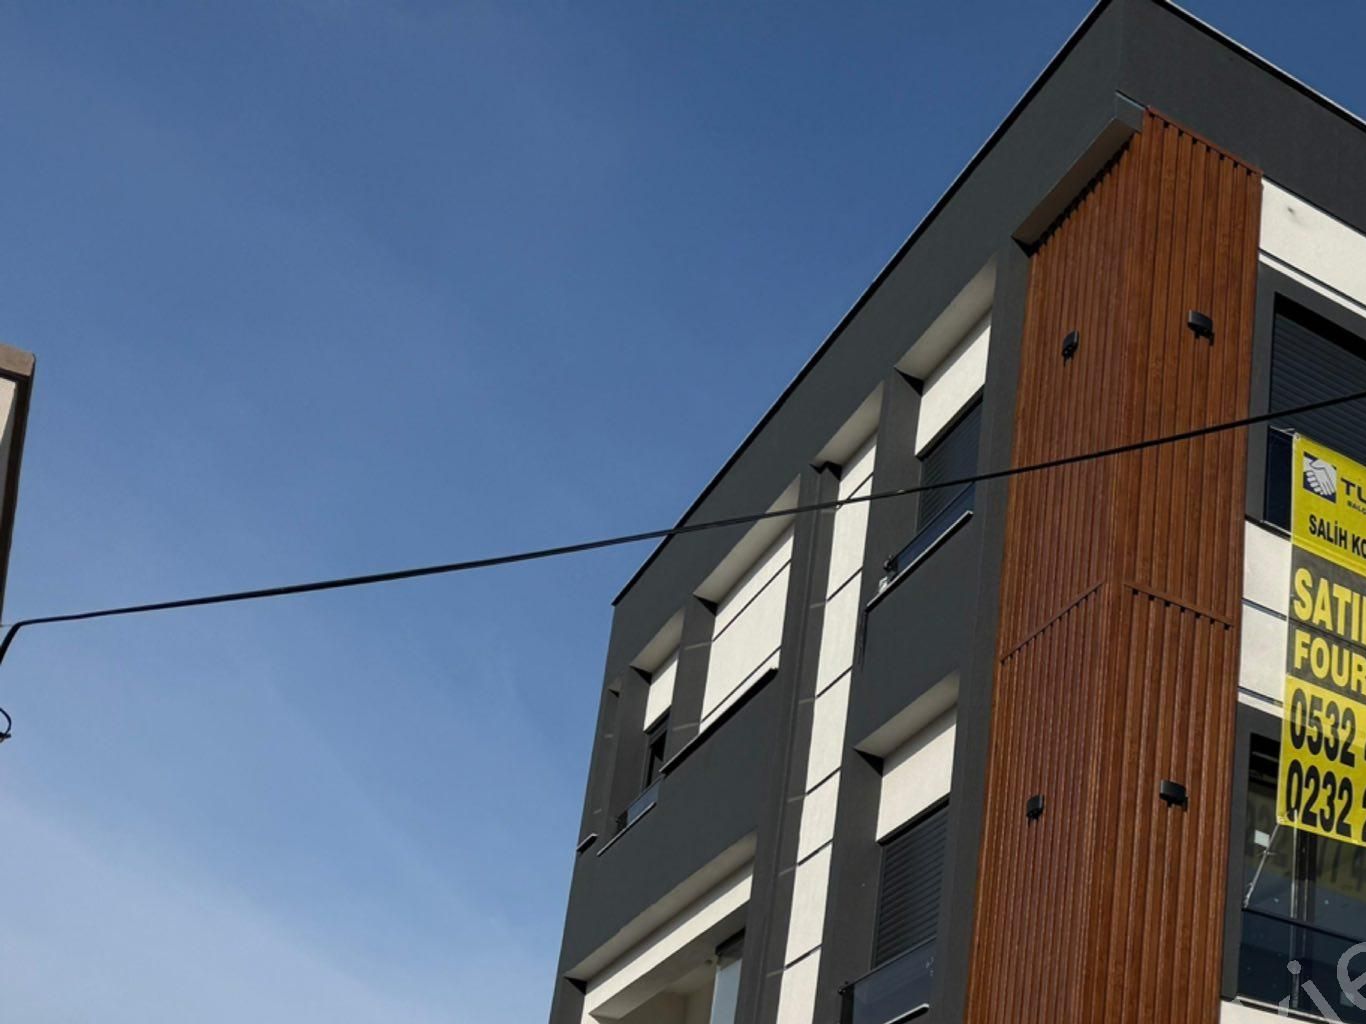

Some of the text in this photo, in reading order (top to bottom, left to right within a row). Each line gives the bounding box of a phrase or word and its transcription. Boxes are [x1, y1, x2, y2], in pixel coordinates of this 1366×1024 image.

[1308, 513, 1348, 549] SALİH
[1290, 687, 1357, 768] 0532
[1285, 759, 1354, 838] 0232
